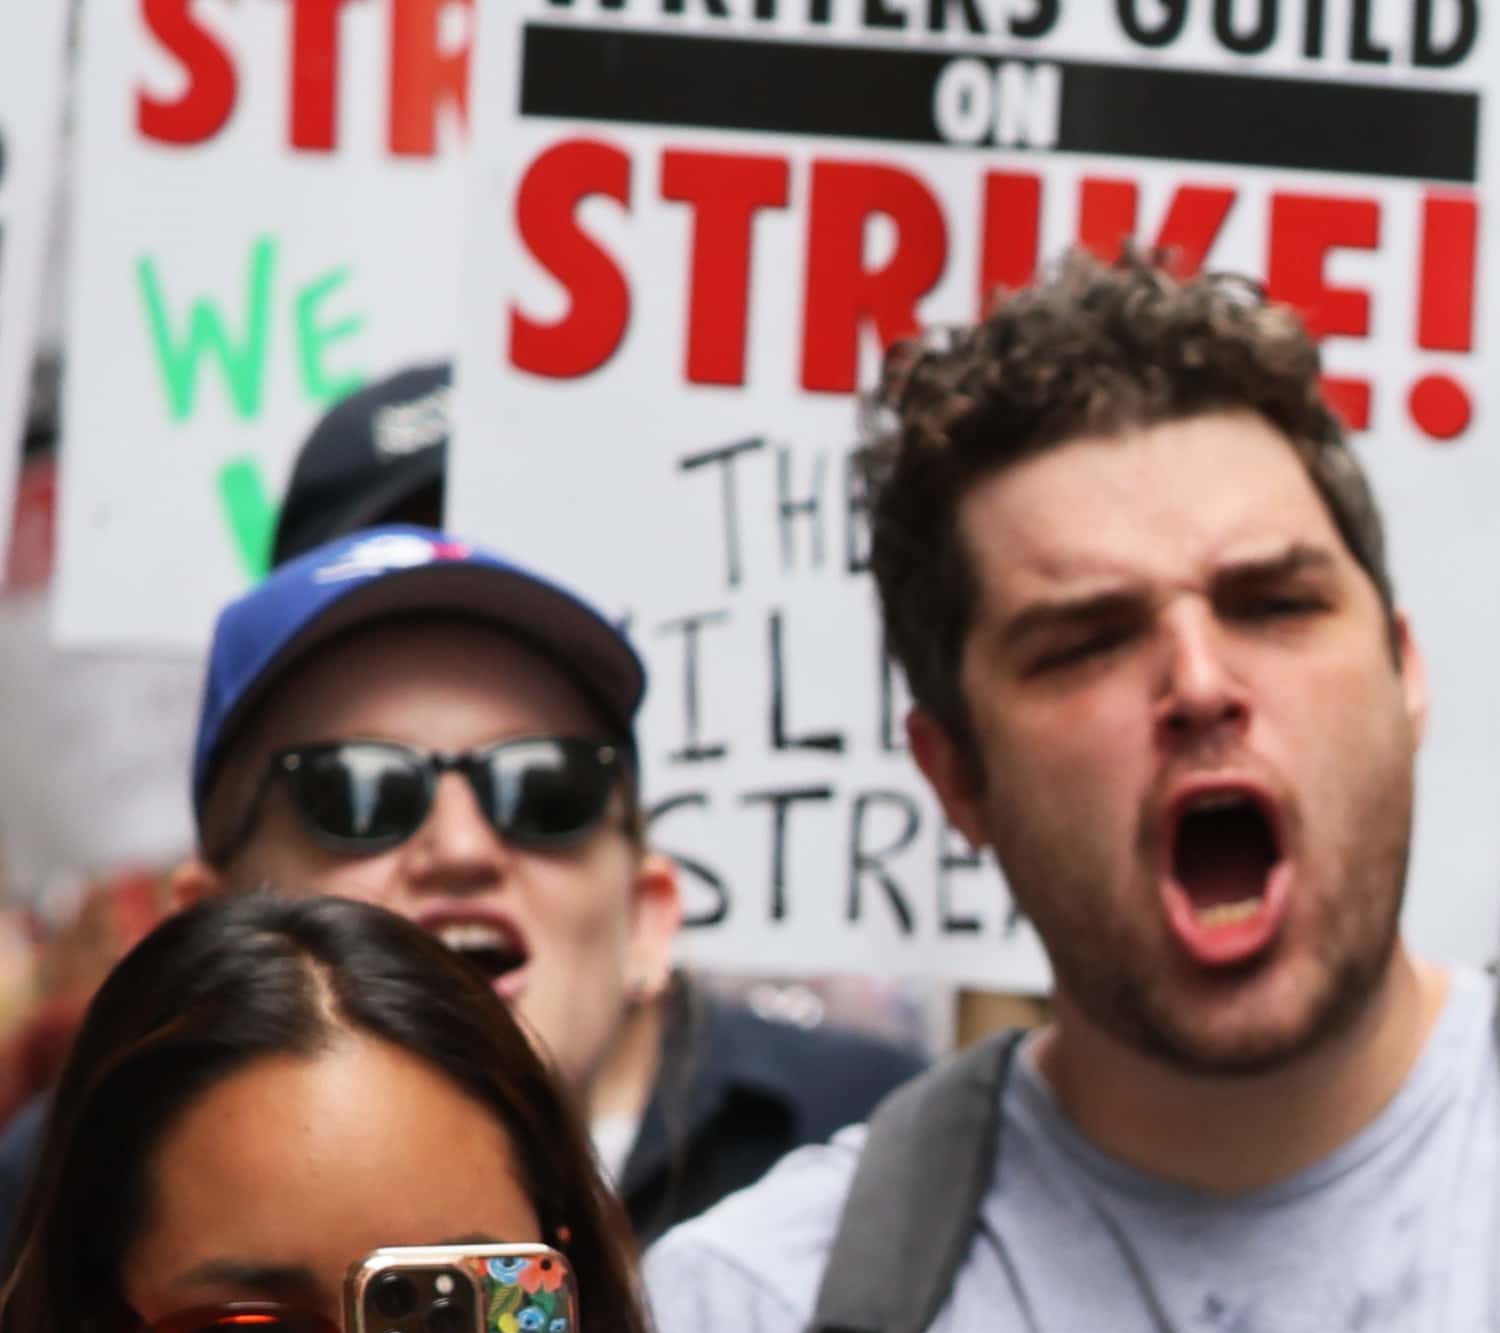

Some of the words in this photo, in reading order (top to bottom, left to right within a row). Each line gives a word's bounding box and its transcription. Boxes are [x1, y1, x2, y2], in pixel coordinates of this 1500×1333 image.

[933, 61, 1061, 148] ON
[137, 234, 368, 422] WE
[645, 788, 1028, 938] STRE
